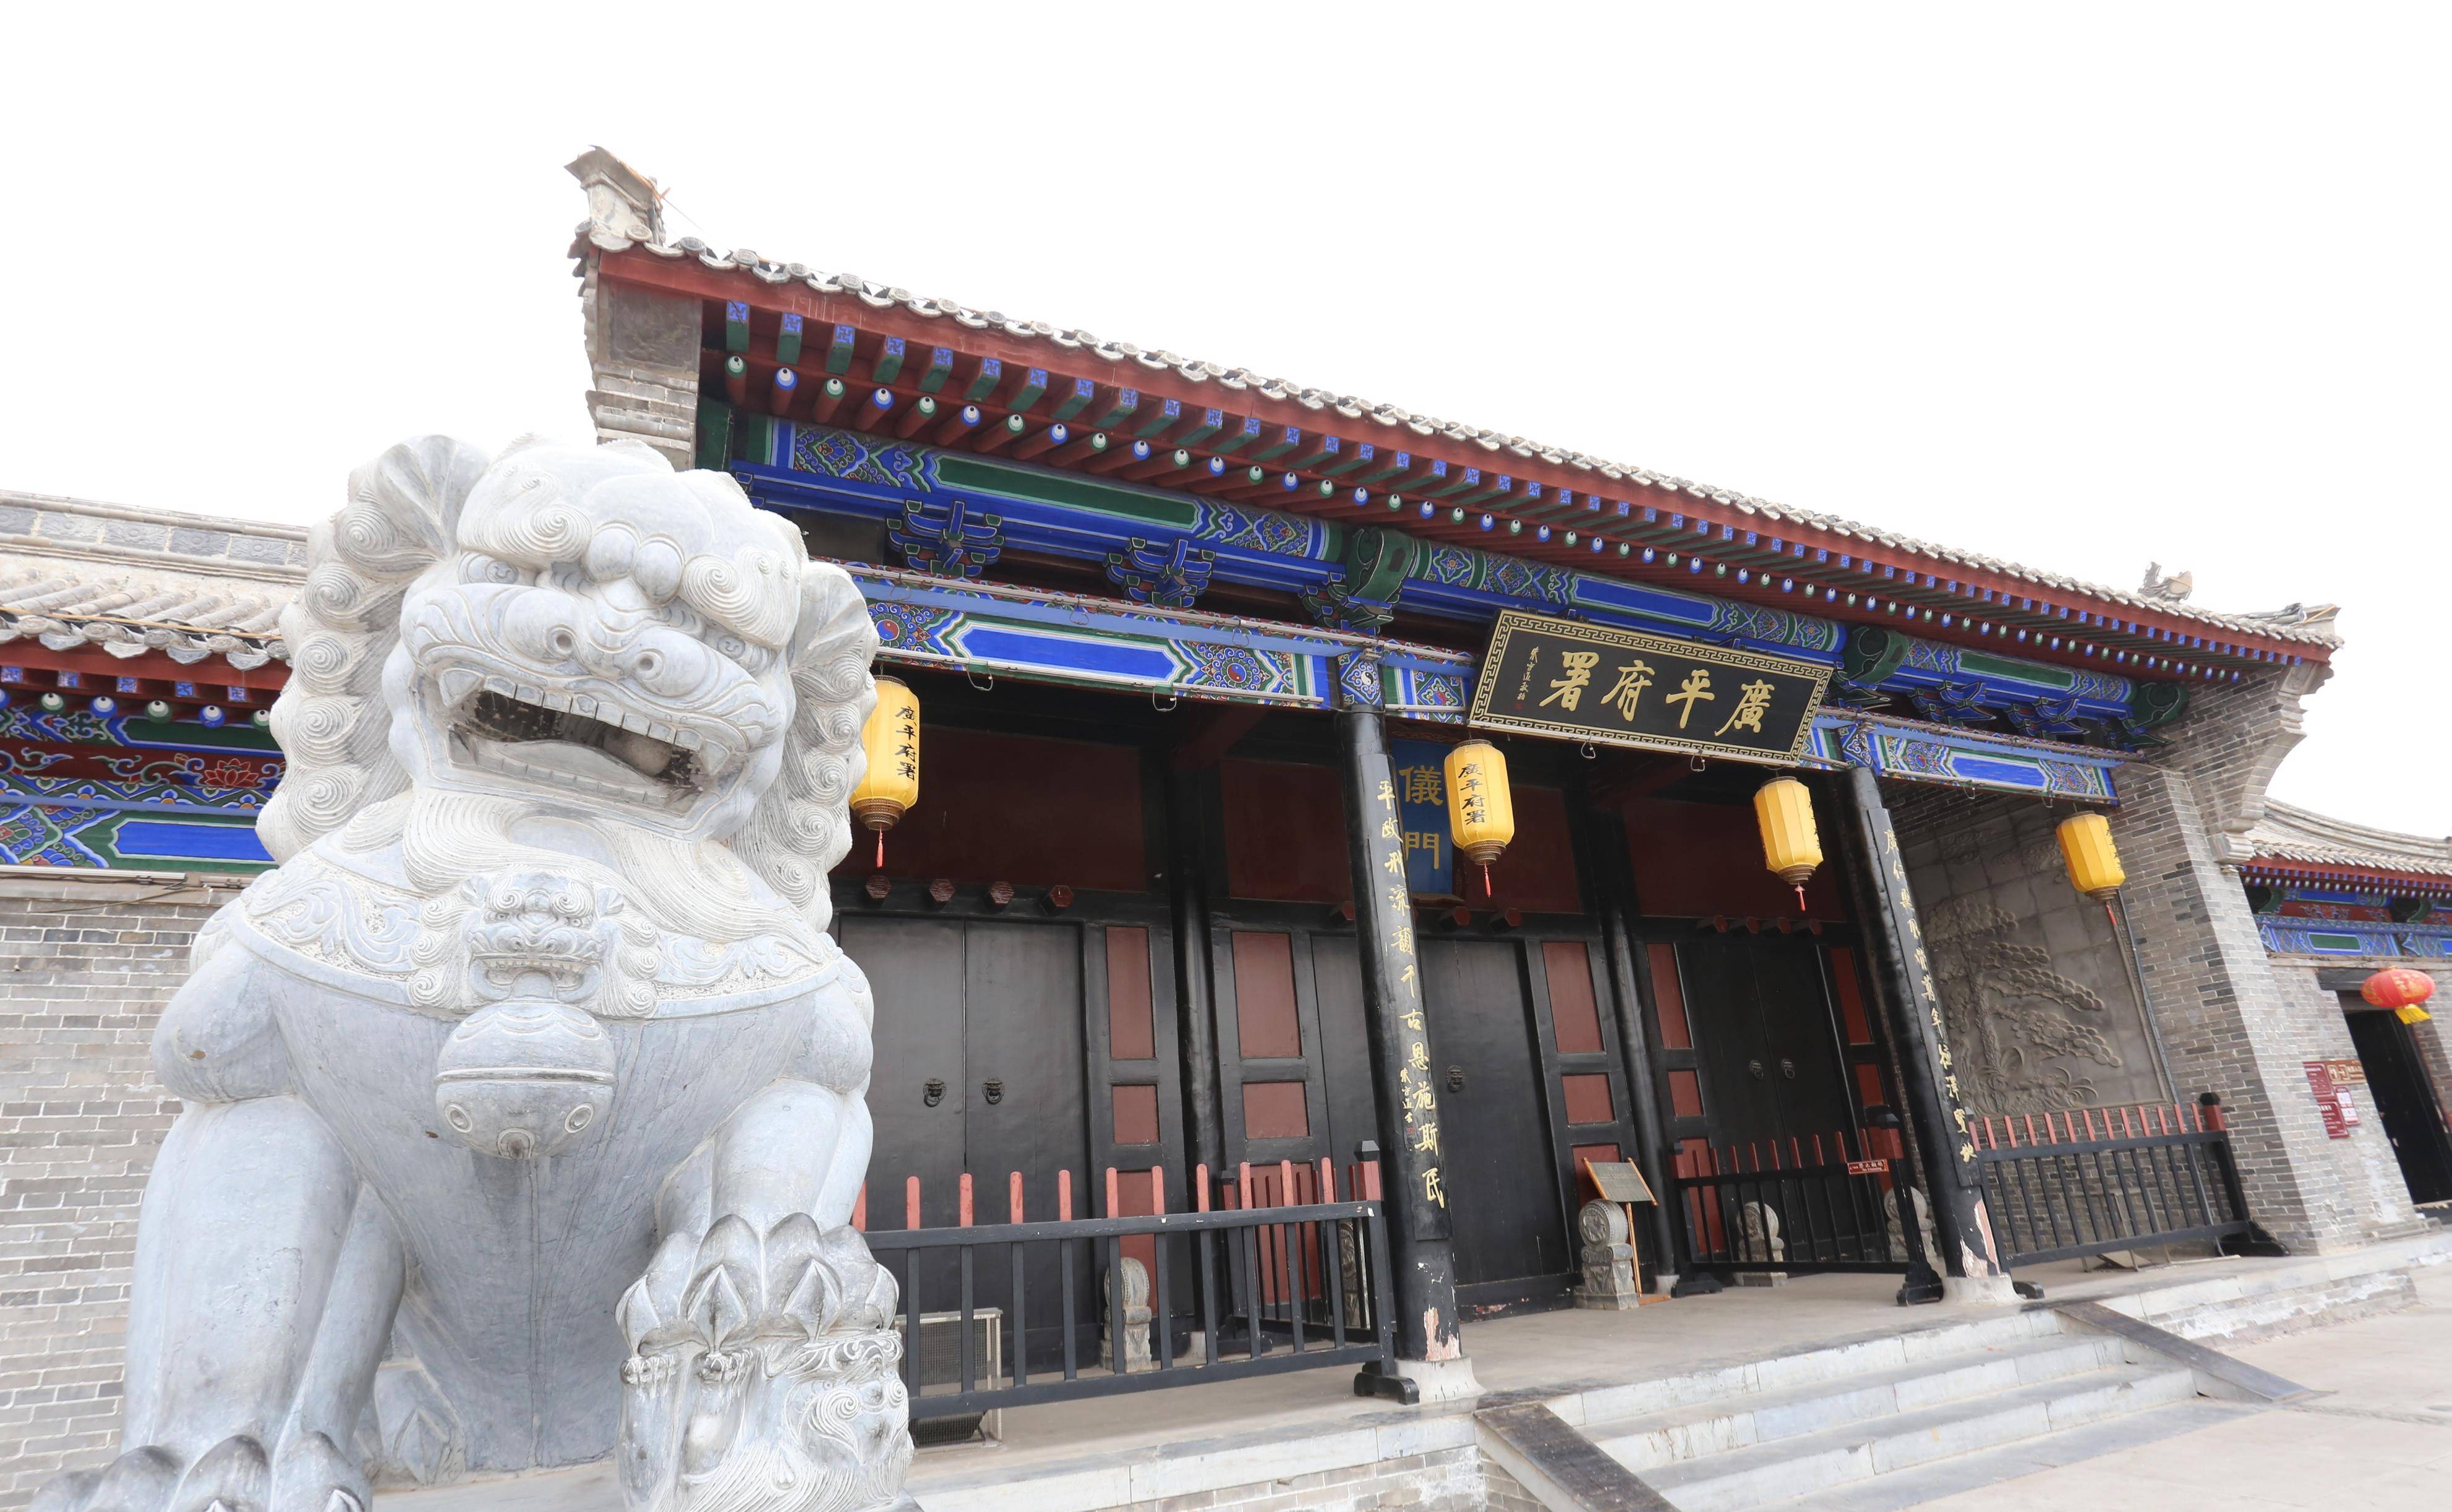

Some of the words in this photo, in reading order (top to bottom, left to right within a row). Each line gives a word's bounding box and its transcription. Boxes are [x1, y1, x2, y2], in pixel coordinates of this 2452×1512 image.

[1539, 651, 1775, 737] 廣平府署
[894, 706, 918, 781] 廣平府署
[1399, 765, 1444, 870] 儀門
[1458, 763, 1487, 826] 廣平府署
